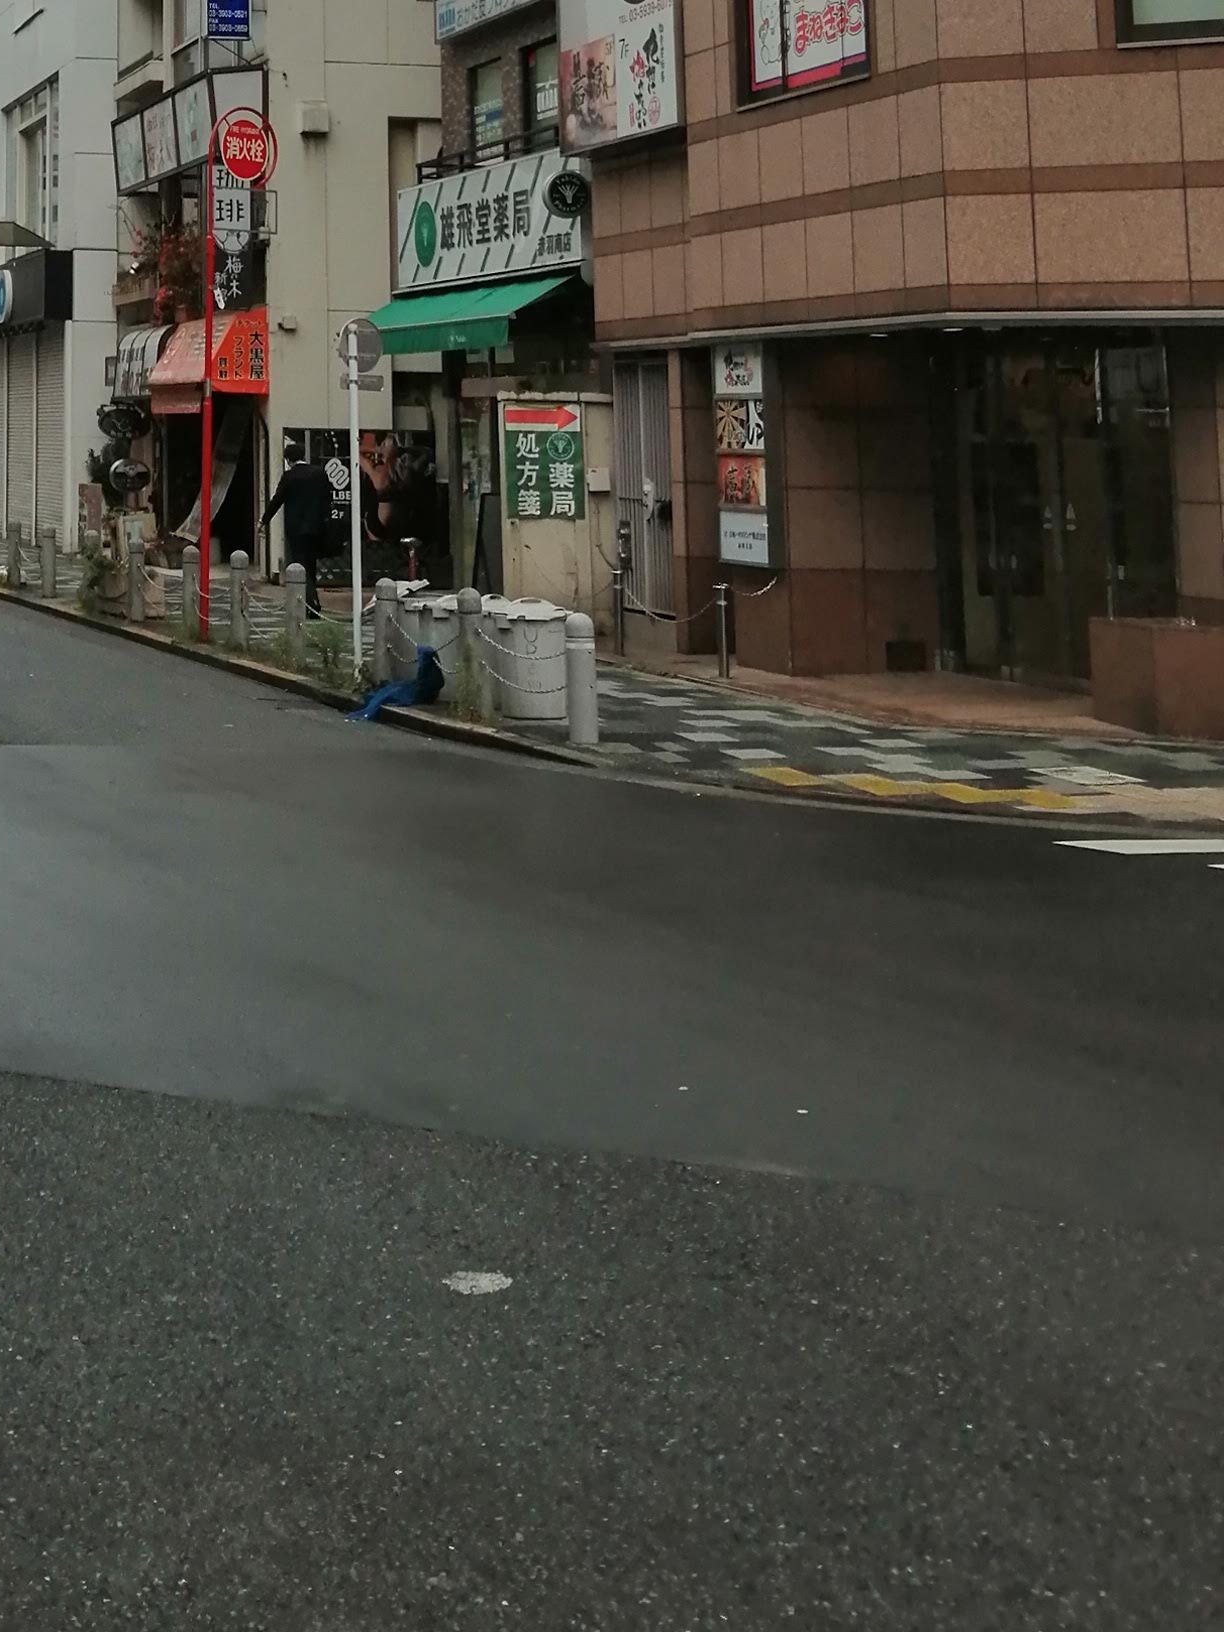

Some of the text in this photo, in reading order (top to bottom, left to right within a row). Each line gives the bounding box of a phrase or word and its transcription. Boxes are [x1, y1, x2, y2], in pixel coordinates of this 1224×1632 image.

[619, 38, 629, 60] 7F
[226, 136, 264, 163] 消火栓
[440, 189, 531, 251] 雄飛堂薬局
[249, 331, 265, 380] 大黒屋
[516, 433, 540, 516] 処方箋
[549, 462, 575, 516] 薬局
[331, 509, 345, 519] 2F
